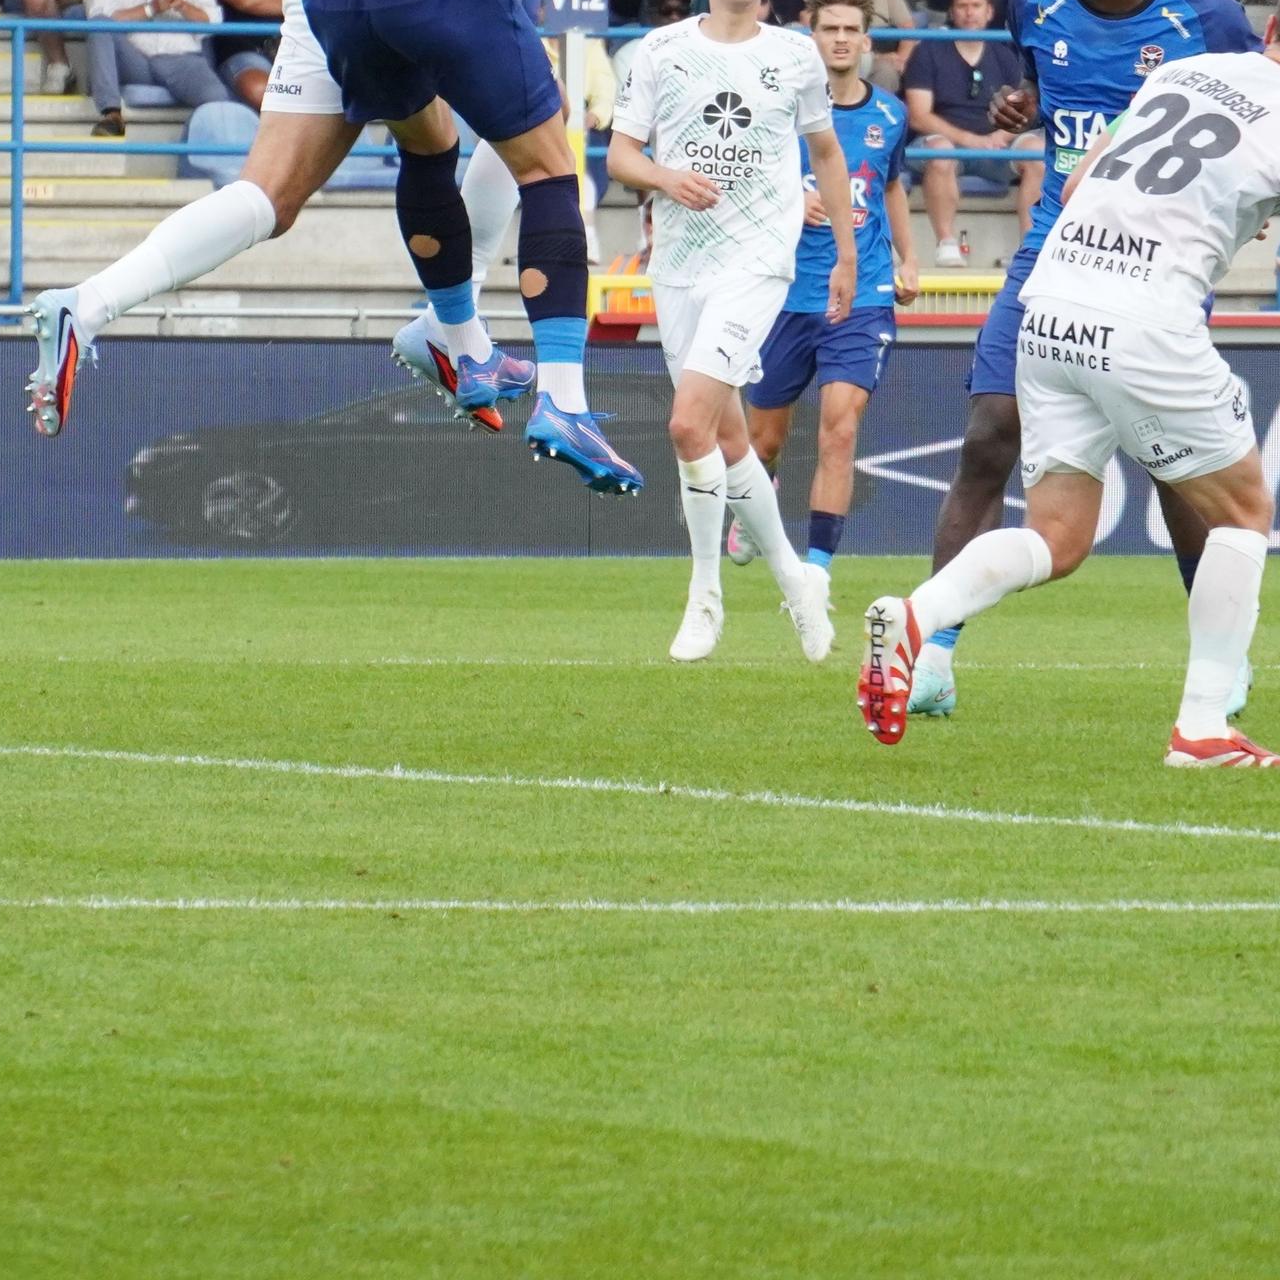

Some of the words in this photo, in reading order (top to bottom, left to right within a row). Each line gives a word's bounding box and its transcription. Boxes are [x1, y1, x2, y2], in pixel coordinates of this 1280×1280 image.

[1054, 109, 1110, 151] STA
[1090, 93, 1241, 195] 28
[684, 141, 763, 164] Golden
[691, 162, 754, 179] palace
[1060, 221, 1162, 262] CALLANT
[1051, 247, 1152, 283] INSURANCE
[1021, 340, 1112, 372] NSURANCE
